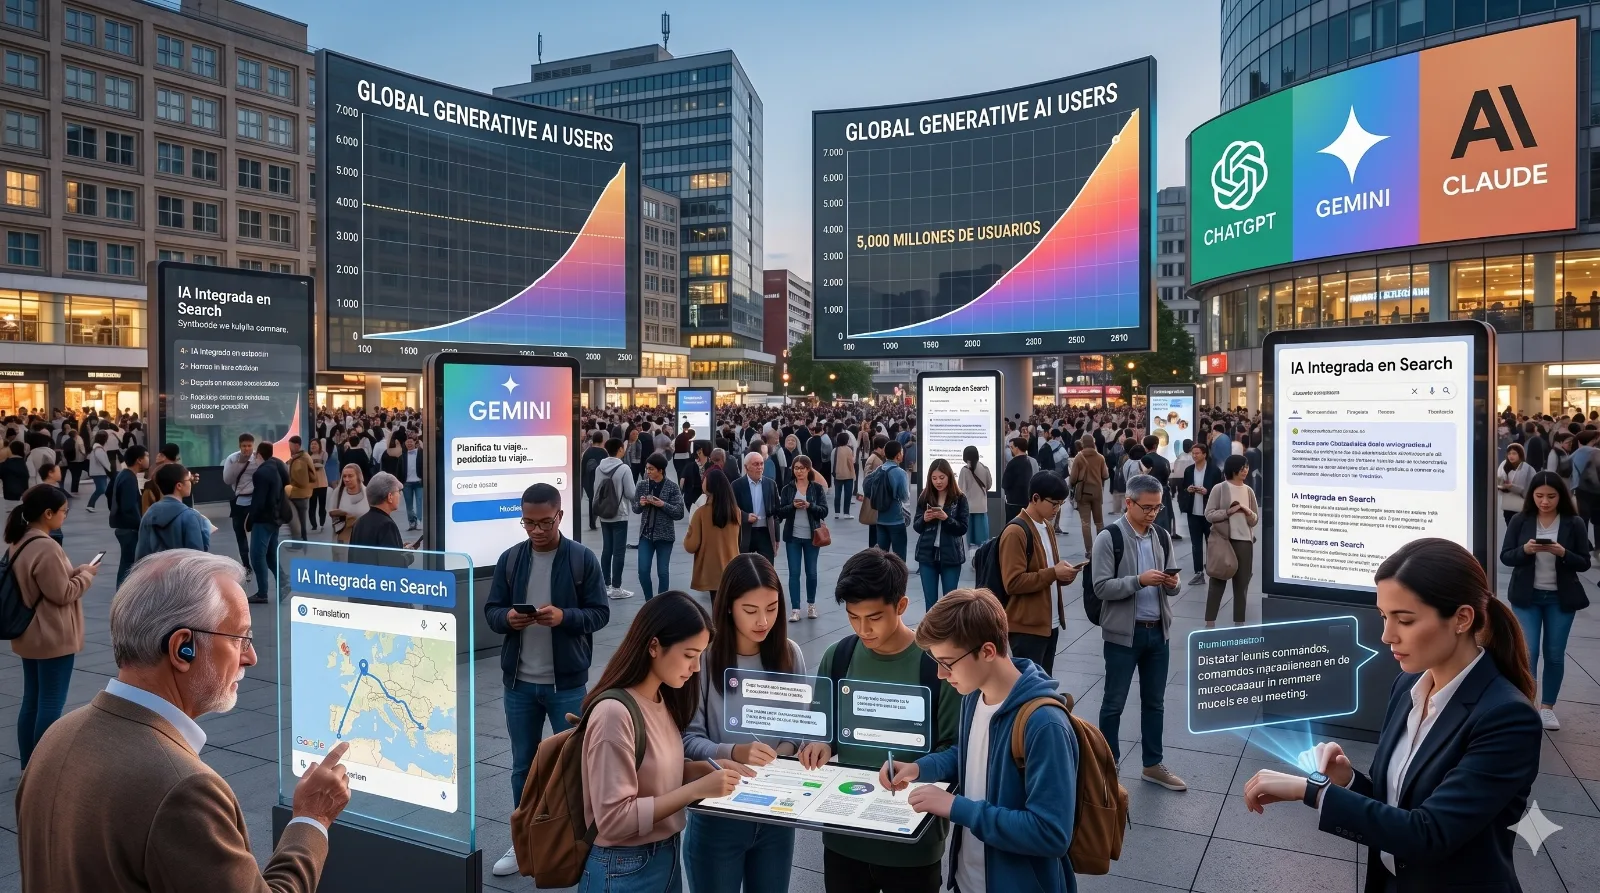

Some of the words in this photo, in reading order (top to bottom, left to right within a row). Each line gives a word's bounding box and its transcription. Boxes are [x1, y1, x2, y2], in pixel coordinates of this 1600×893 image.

[336, 103, 359, 118] 7.000
[357, 79, 430, 117] GLOBAL
[433, 100, 538, 140] GENERATIVE
[541, 123, 558, 143] AI
[562, 126, 614, 152] USERS
[845, 118, 915, 142] GLOBAL
[919, 100, 1029, 135] GENERATIVE
[1033, 96, 1052, 119] AI
[1057, 82, 1118, 114] USERS
[336, 134, 359, 147] 6.000
[823, 148, 844, 157] 7.000
[336, 165, 359, 178] 5.000
[823, 173, 844, 182] 6.000
[1442, 163, 1548, 196] CLAUDE
[336, 196, 359, 209] 4.000
[823, 199, 844, 208] 5.000
[1315, 188, 1390, 218] GEMINI
[823, 225, 844, 234] 4.000
[856, 233, 890, 250] 5,000
[893, 229, 955, 247] MILLONES
[958, 227, 974, 242] DE
[977, 220, 1041, 240] USUARIOS
[1203, 212, 1277, 246] CHATGPT
[336, 231, 359, 242] 3.000
[823, 251, 844, 261] 3.000
[336, 264, 359, 275] 2.000
[823, 278, 844, 287] 2.000
[178, 285, 192, 299] IA
[195, 287, 254, 304] Integrada
[256, 295, 271, 305] en
[178, 301, 222, 317] Search
[336, 299, 359, 308] 1.000
[823, 305, 844, 314] 1.000
[352, 331, 359, 341] 0
[837, 332, 844, 340] 0
[882, 342, 899, 350] 1000
[964, 339, 981, 348] 2000
[1067, 335, 1086, 344] 2500
[199, 348, 231, 357] Integrada
[357, 345, 372, 354] 100
[399, 346, 418, 356] 1600
[585, 353, 601, 361] 2000
[617, 353, 633, 362] 2500
[1291, 361, 1305, 375] IA
[1308, 359, 1374, 377] Integrada
[1378, 360, 1396, 372] en
[1399, 356, 1453, 371] Search
[935, 385, 961, 393] Integrada
[468, 400, 551, 421] GEMINI
[456, 443, 492, 452] Planifica
[493, 443, 502, 451] tu
[498, 454, 507, 462] tu
[1300, 492, 1336, 502] Integrada
[1337, 494, 1347, 502] en
[1348, 495, 1376, 503] Search
[1340, 540, 1365, 549] Search
[297, 568, 311, 584] IA
[314, 569, 377, 591] Integrada
[380, 579, 396, 592] en
[400, 577, 448, 597] Search
[312, 607, 350, 619] Translation
[1198, 653, 1239, 666] Distatar
[1323, 658, 1336, 667] en
[1337, 655, 1350, 665] de
[1267, 677, 1276, 687] in
[1236, 696, 1249, 705] ee
[1251, 695, 1264, 703] eu
[1265, 688, 1309, 701] meeting.
[296, 735, 325, 750] Google
